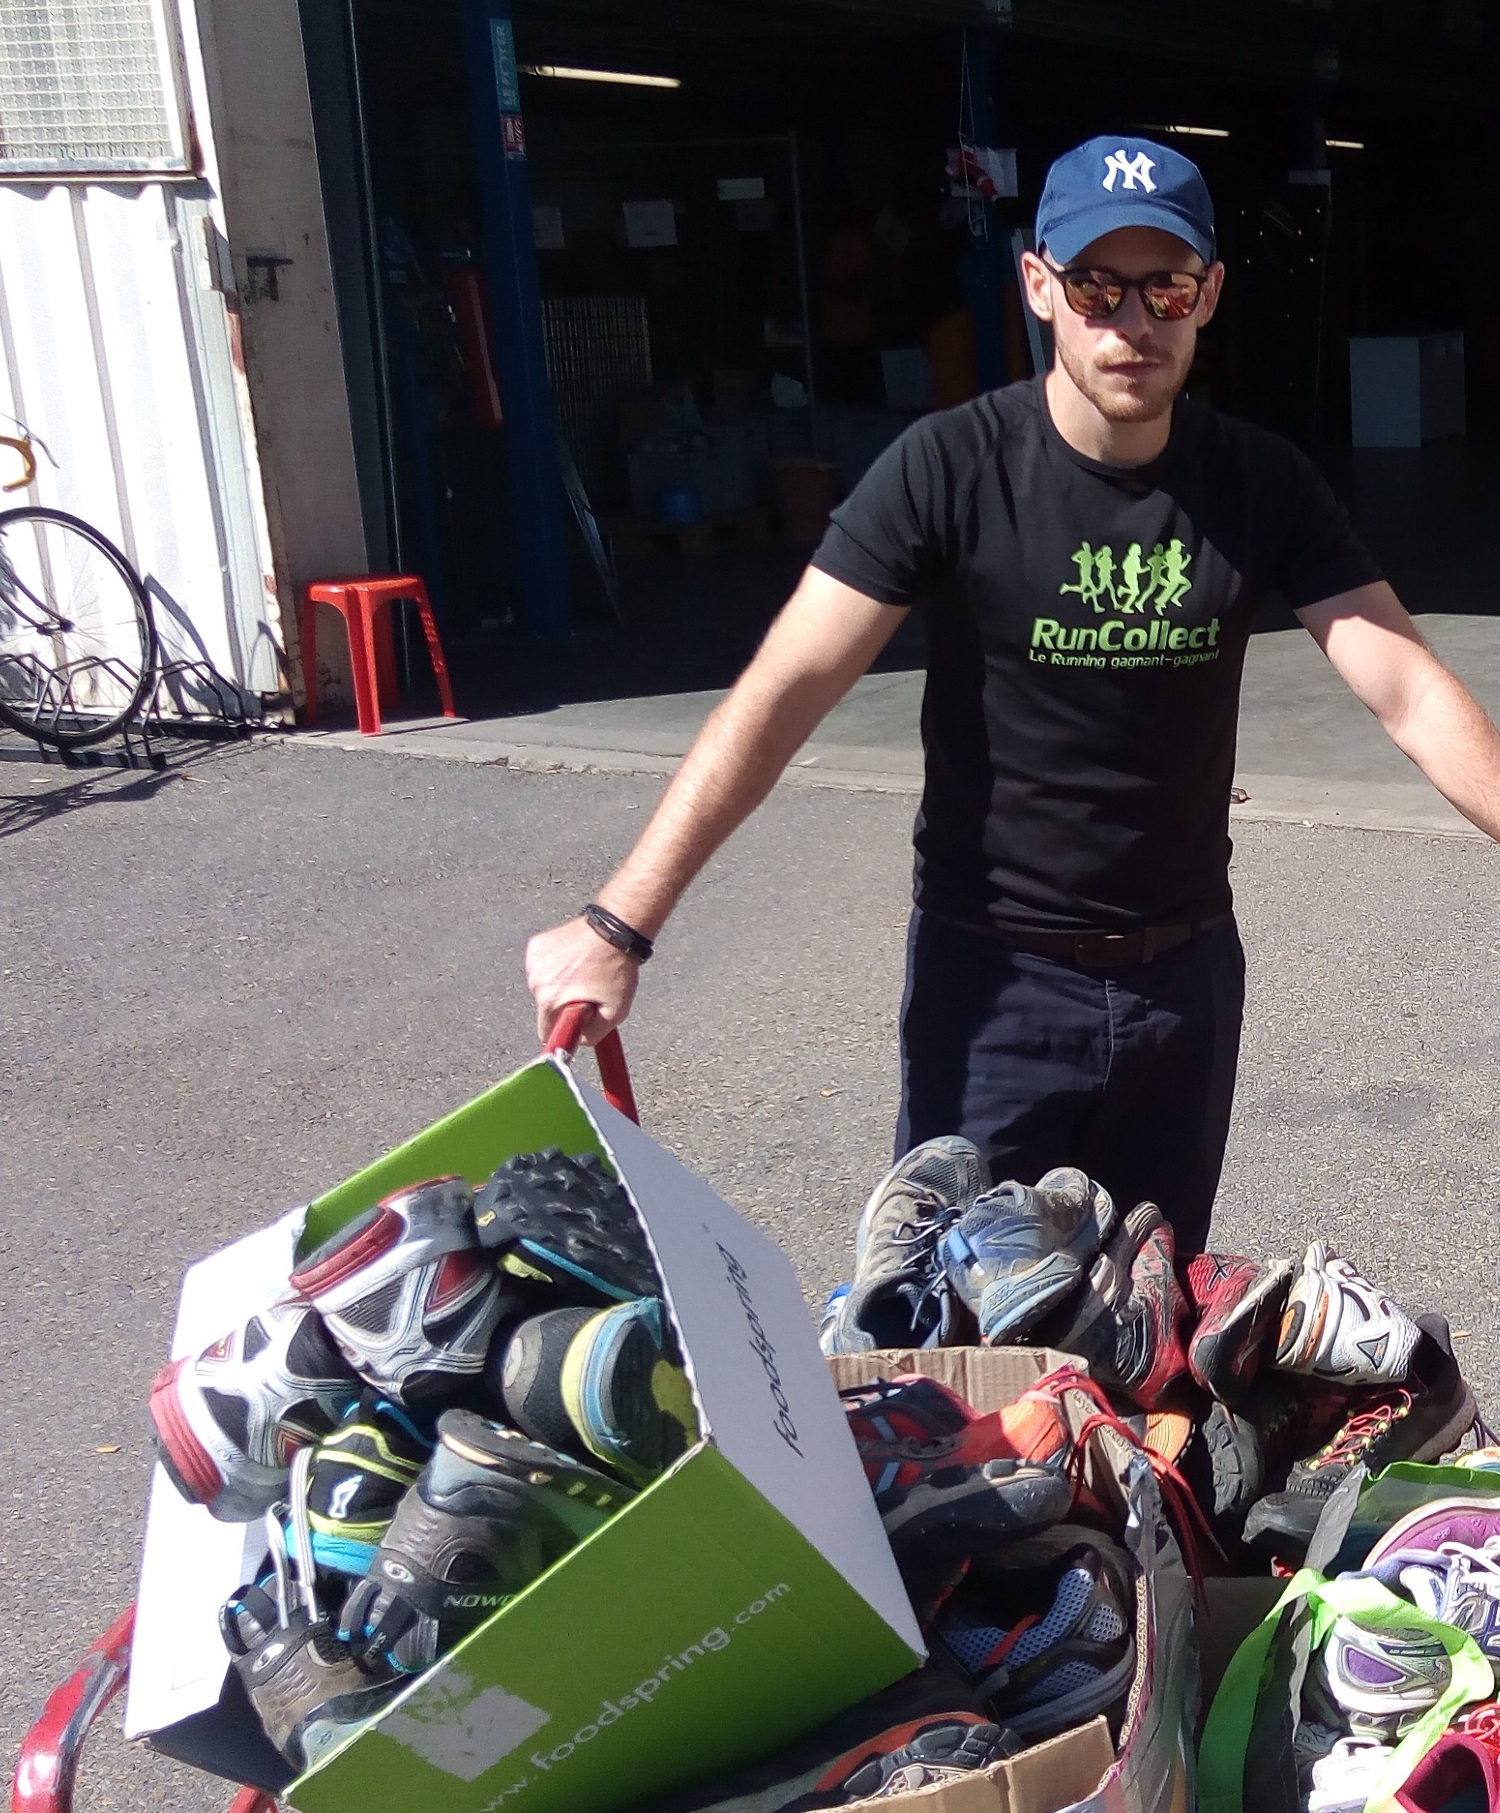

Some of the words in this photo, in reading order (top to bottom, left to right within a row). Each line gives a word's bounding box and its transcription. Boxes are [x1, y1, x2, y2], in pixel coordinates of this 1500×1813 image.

[1103, 149, 1158, 194] NY
[1031, 618, 1220, 651] RunCollect
[1029, 649, 1047, 664] Le
[1051, 653, 1106, 669] Running
[1111, 650, 1219, 669] gagnant-gagnant
[715, 1241, 804, 1459] foodspring
